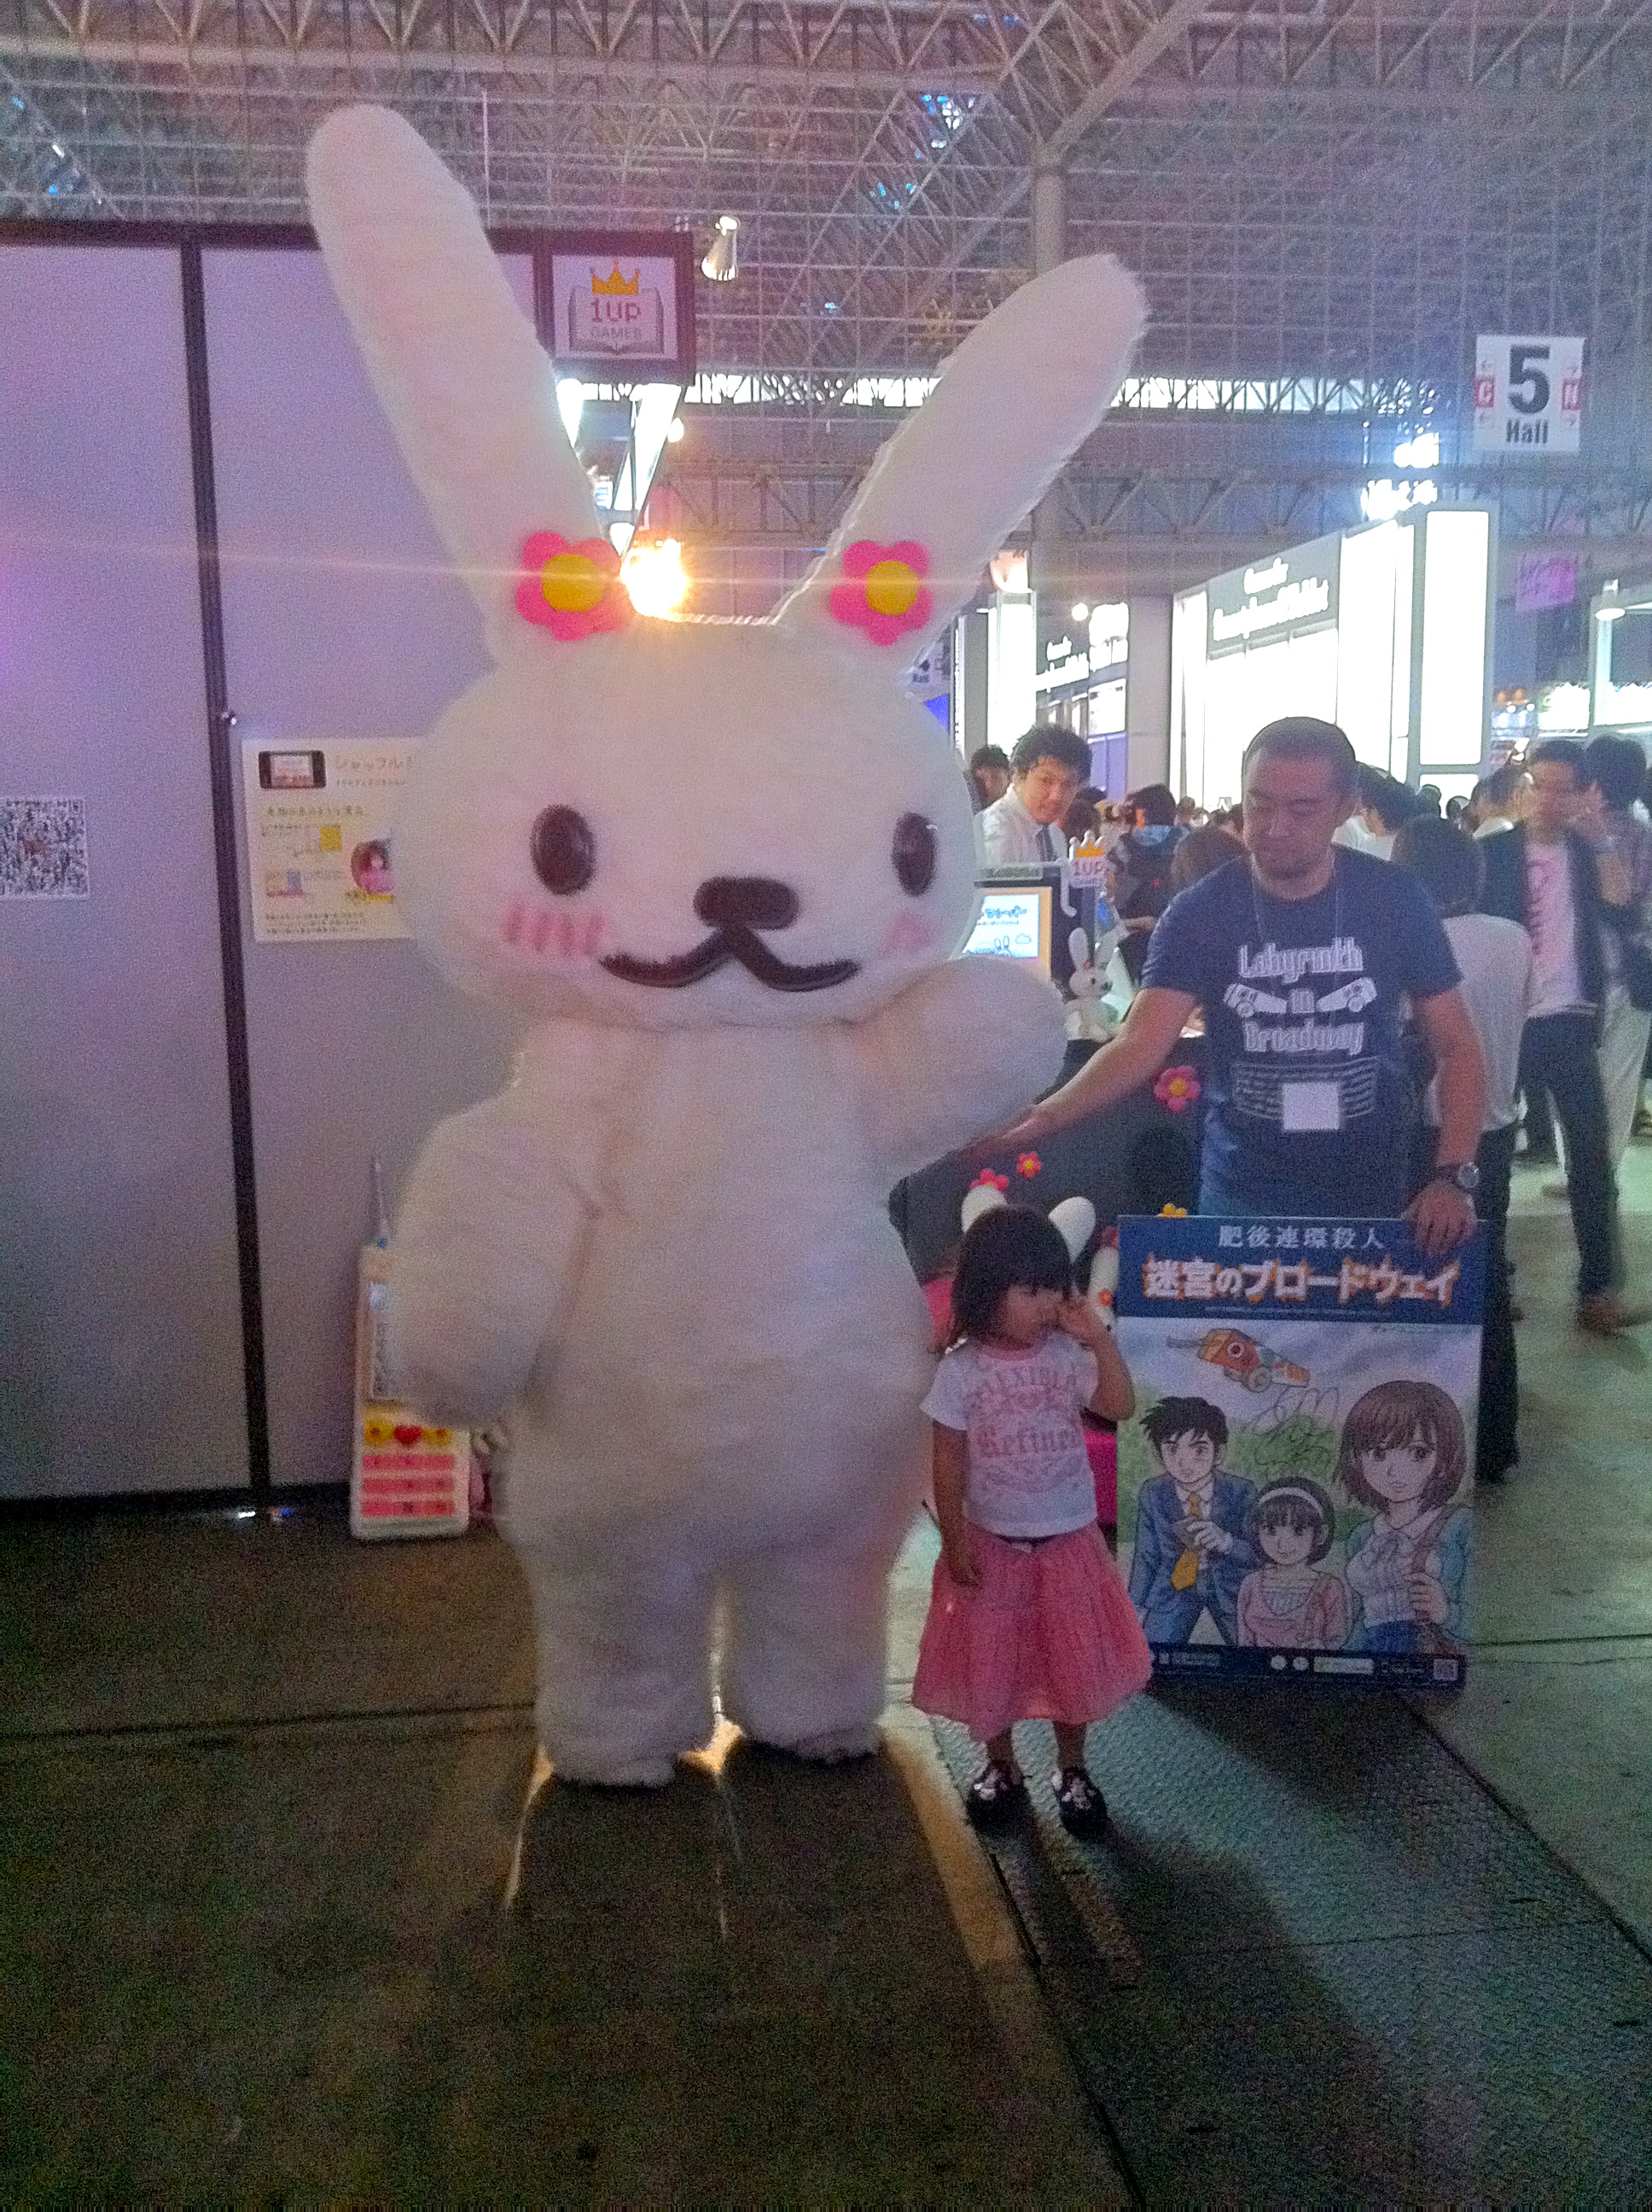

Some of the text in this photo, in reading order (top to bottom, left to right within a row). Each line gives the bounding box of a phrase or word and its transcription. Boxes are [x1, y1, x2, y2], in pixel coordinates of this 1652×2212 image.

[592, 298, 642, 323] 1UP
[1507, 345, 1550, 414] 5
[1506, 420, 1549, 444] Hall
[1238, 936, 1365, 984] Labyrinth
[1242, 1018, 1366, 1057] Broadway
[1218, 1225, 1386, 1250] 肥後連環殺人
